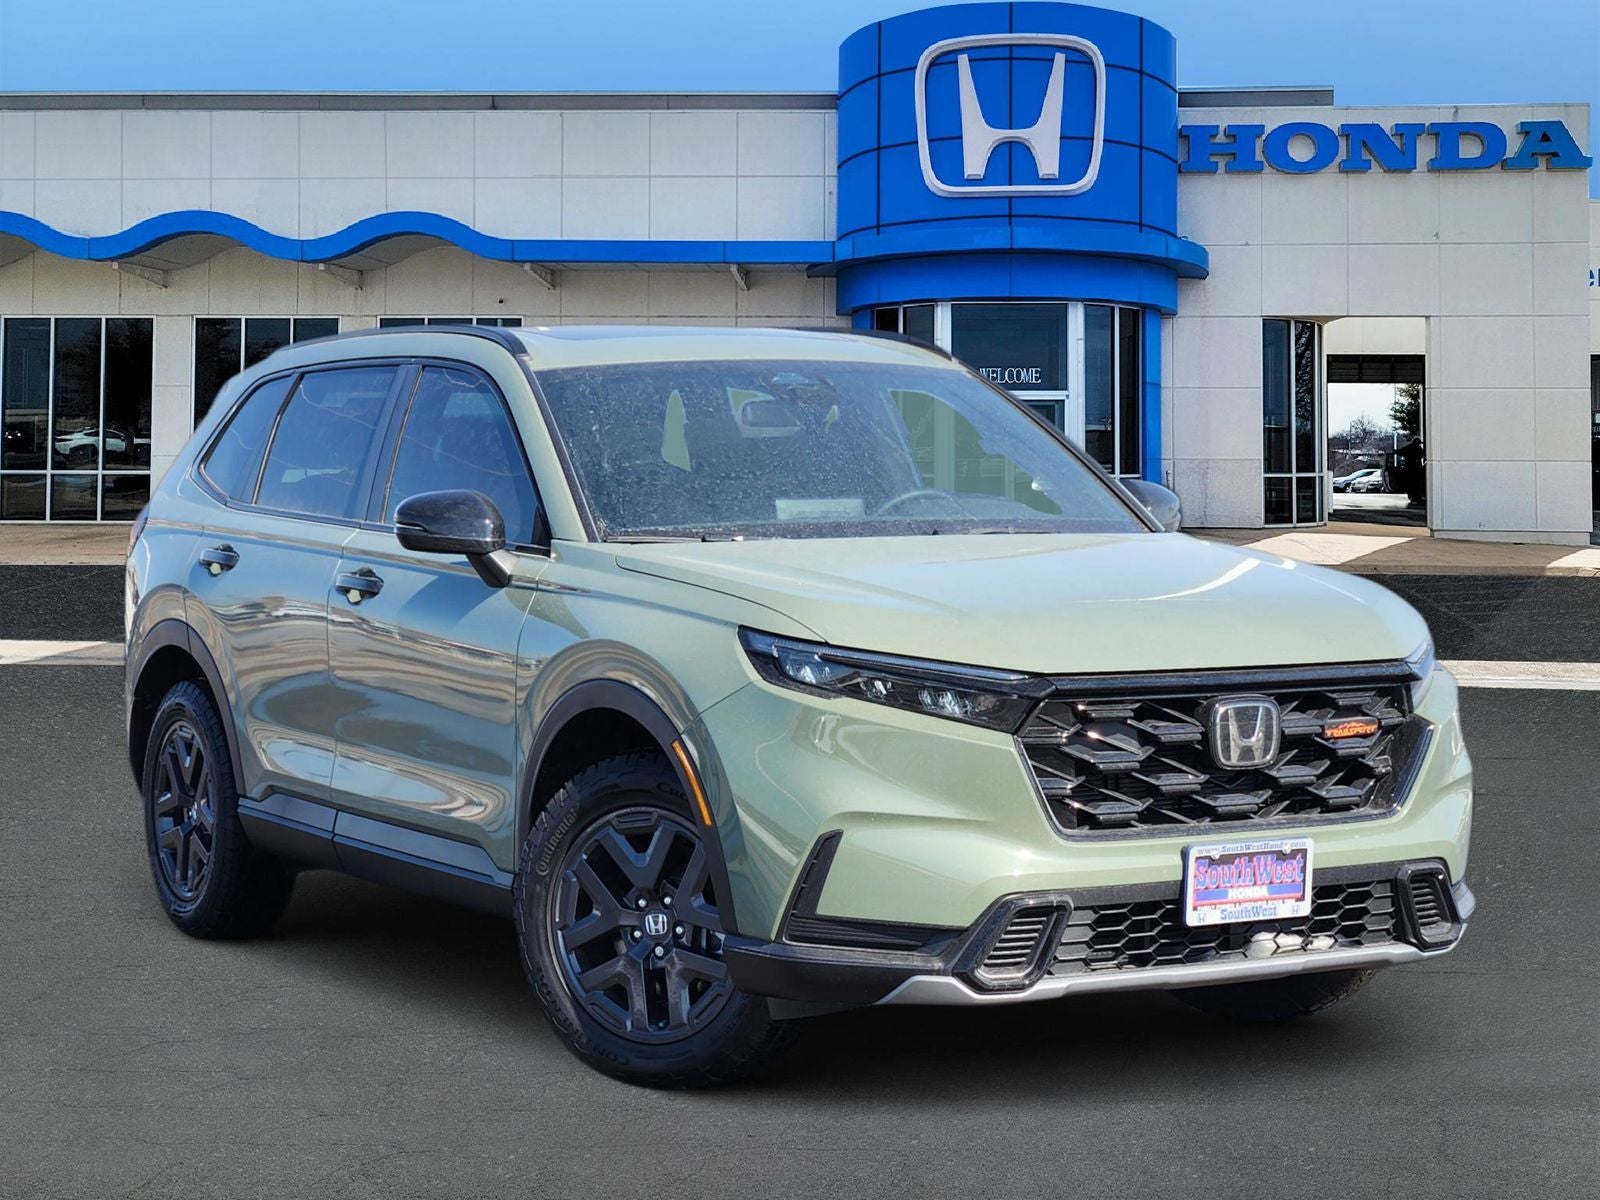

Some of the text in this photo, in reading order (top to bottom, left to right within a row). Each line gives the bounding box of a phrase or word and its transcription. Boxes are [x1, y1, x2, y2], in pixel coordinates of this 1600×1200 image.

[1178, 121, 1592, 174] HONDA
[979, 367, 1041, 383] WELCOME
[535, 811, 577, 876] Continental
[1194, 854, 1304, 888] SouthWest
[1229, 885, 1269, 899] HONDA
[1220, 905, 1278, 921] SouthWest
